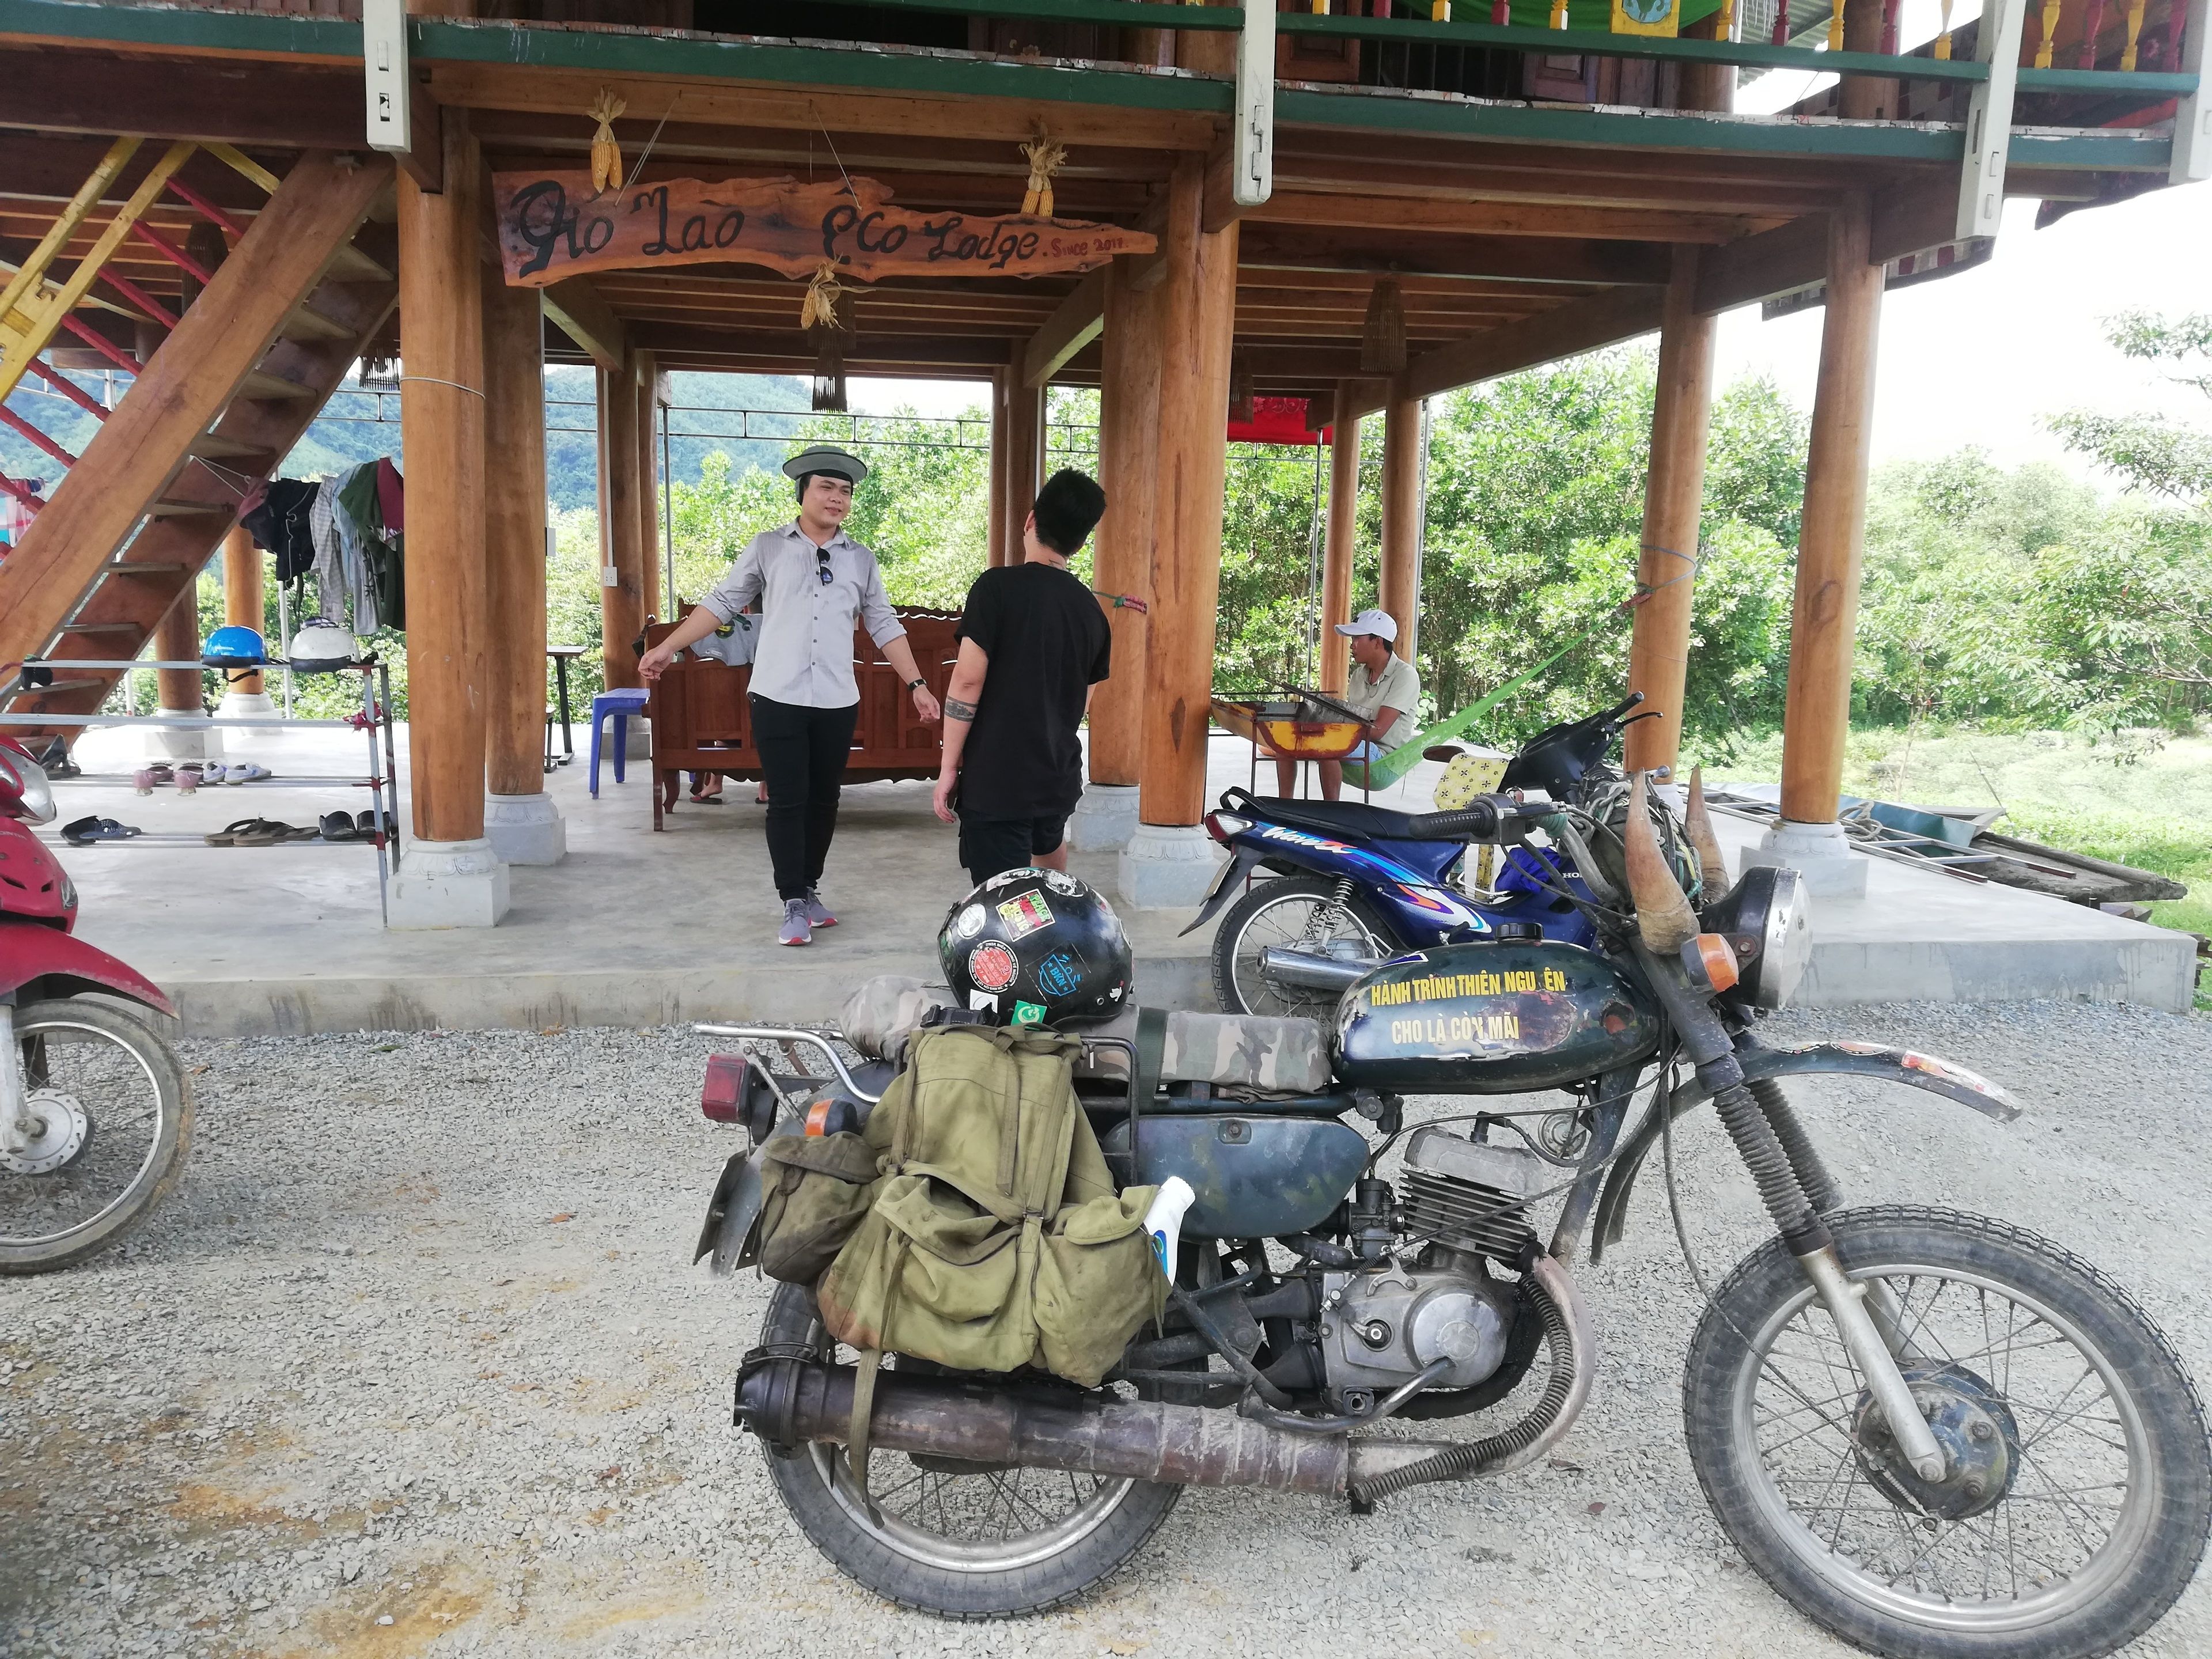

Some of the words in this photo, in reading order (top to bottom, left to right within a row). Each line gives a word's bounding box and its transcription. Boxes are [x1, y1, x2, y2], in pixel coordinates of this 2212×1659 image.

[1372, 980, 1411, 1006] HÀNH
[1412, 974, 1457, 1001] TRÌNH
[1456, 969, 1501, 997] THIÊN
[1392, 1019, 1423, 1044] CHO
[1427, 1012, 1447, 1043] LÀ
[1488, 1012, 1520, 1040] MÃI
